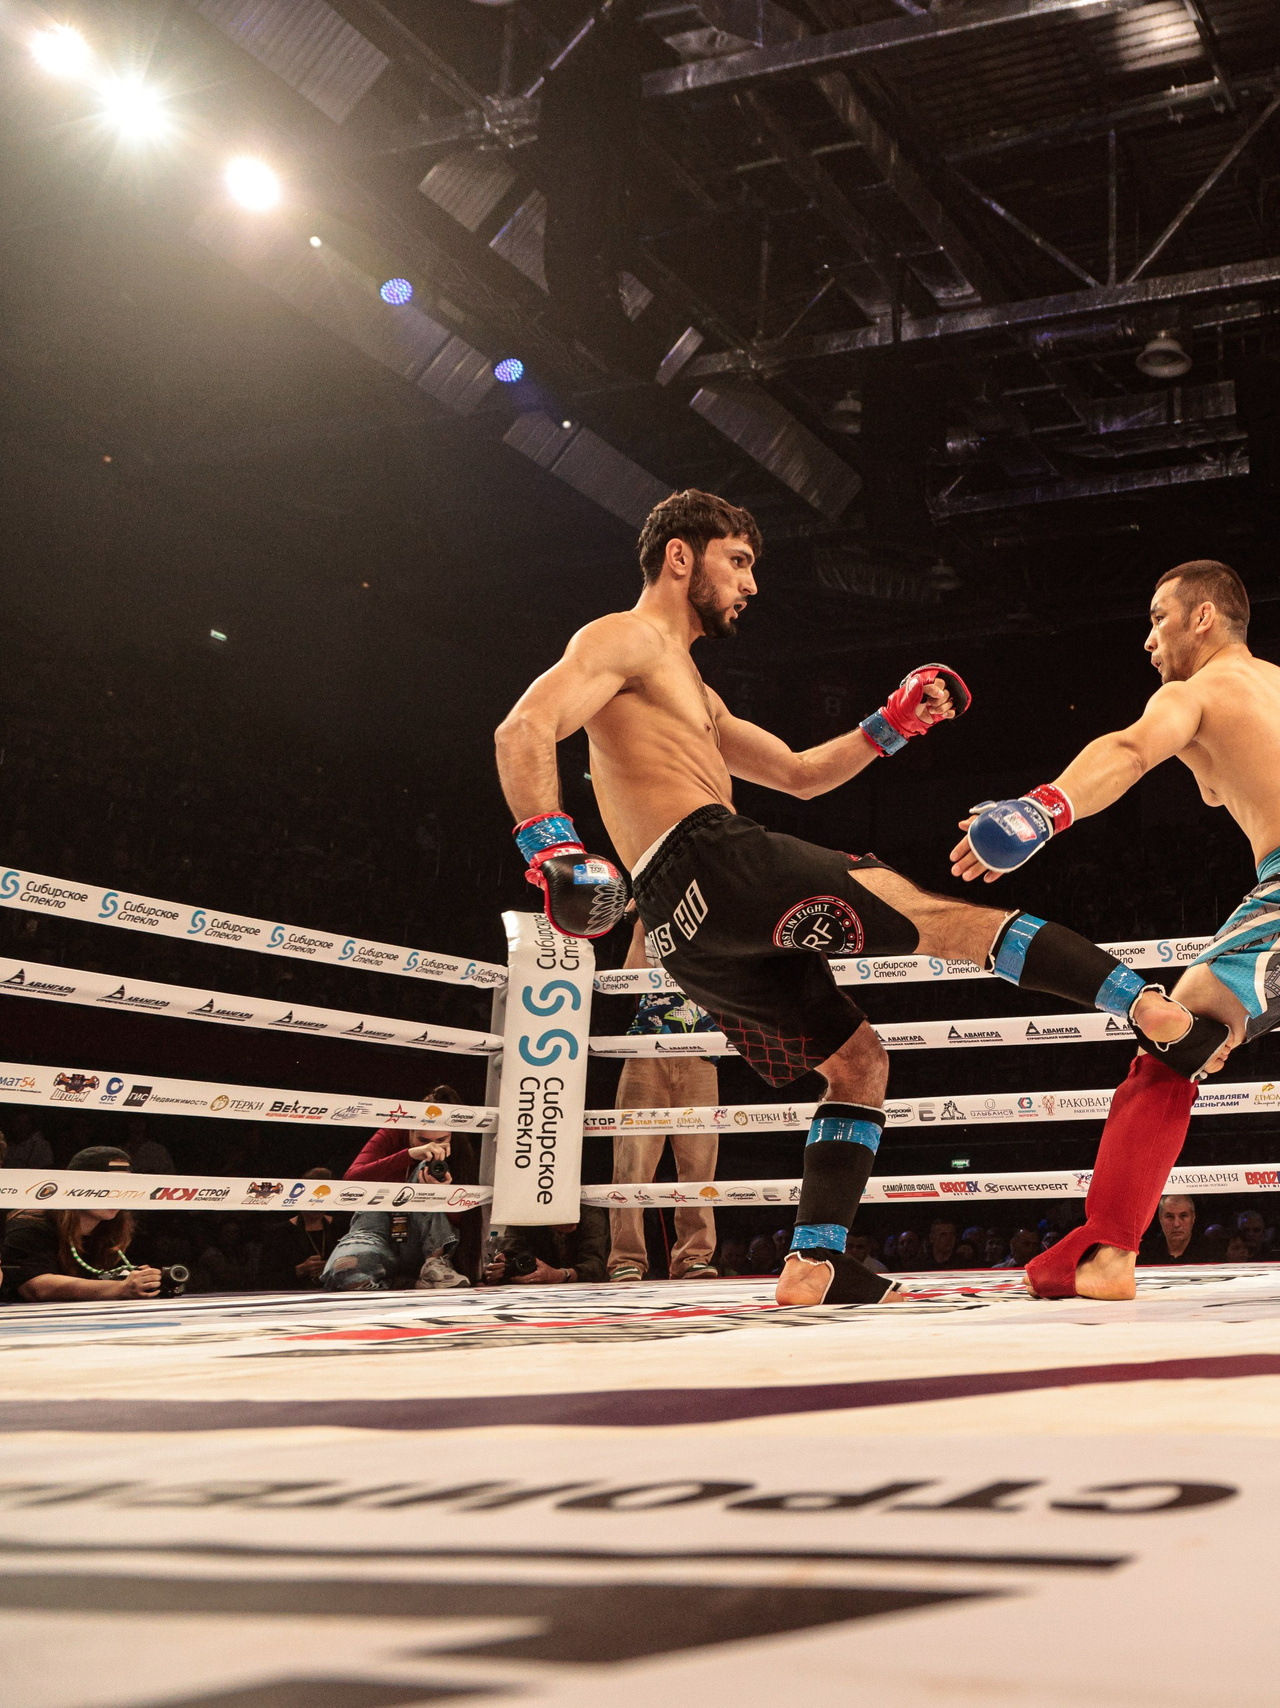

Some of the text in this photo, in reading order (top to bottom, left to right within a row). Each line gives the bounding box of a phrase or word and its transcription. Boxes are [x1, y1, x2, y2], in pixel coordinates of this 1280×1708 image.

[25, 880, 88, 902] Сибирское
[20, 891, 66, 909] Стекло
[123, 900, 179, 920] Сибирское
[796, 904, 830, 919] FIGHT
[117, 911, 159, 927] Стекло
[204, 927, 242, 941] Стекло
[210, 918, 261, 936] Сибирское
[873, 960, 918, 972] Сибирское
[874, 969, 907, 977] Стекло
[1059, 1096, 1112, 1108] РАКОВАР
[515, 1077, 540, 1169] Стекло
[536, 1077, 564, 1204] Сибирское
[1170, 1173, 1239, 1184] РАКОВАРНЯ
[999, 1183, 1068, 1192] FIGHTEXPERT
